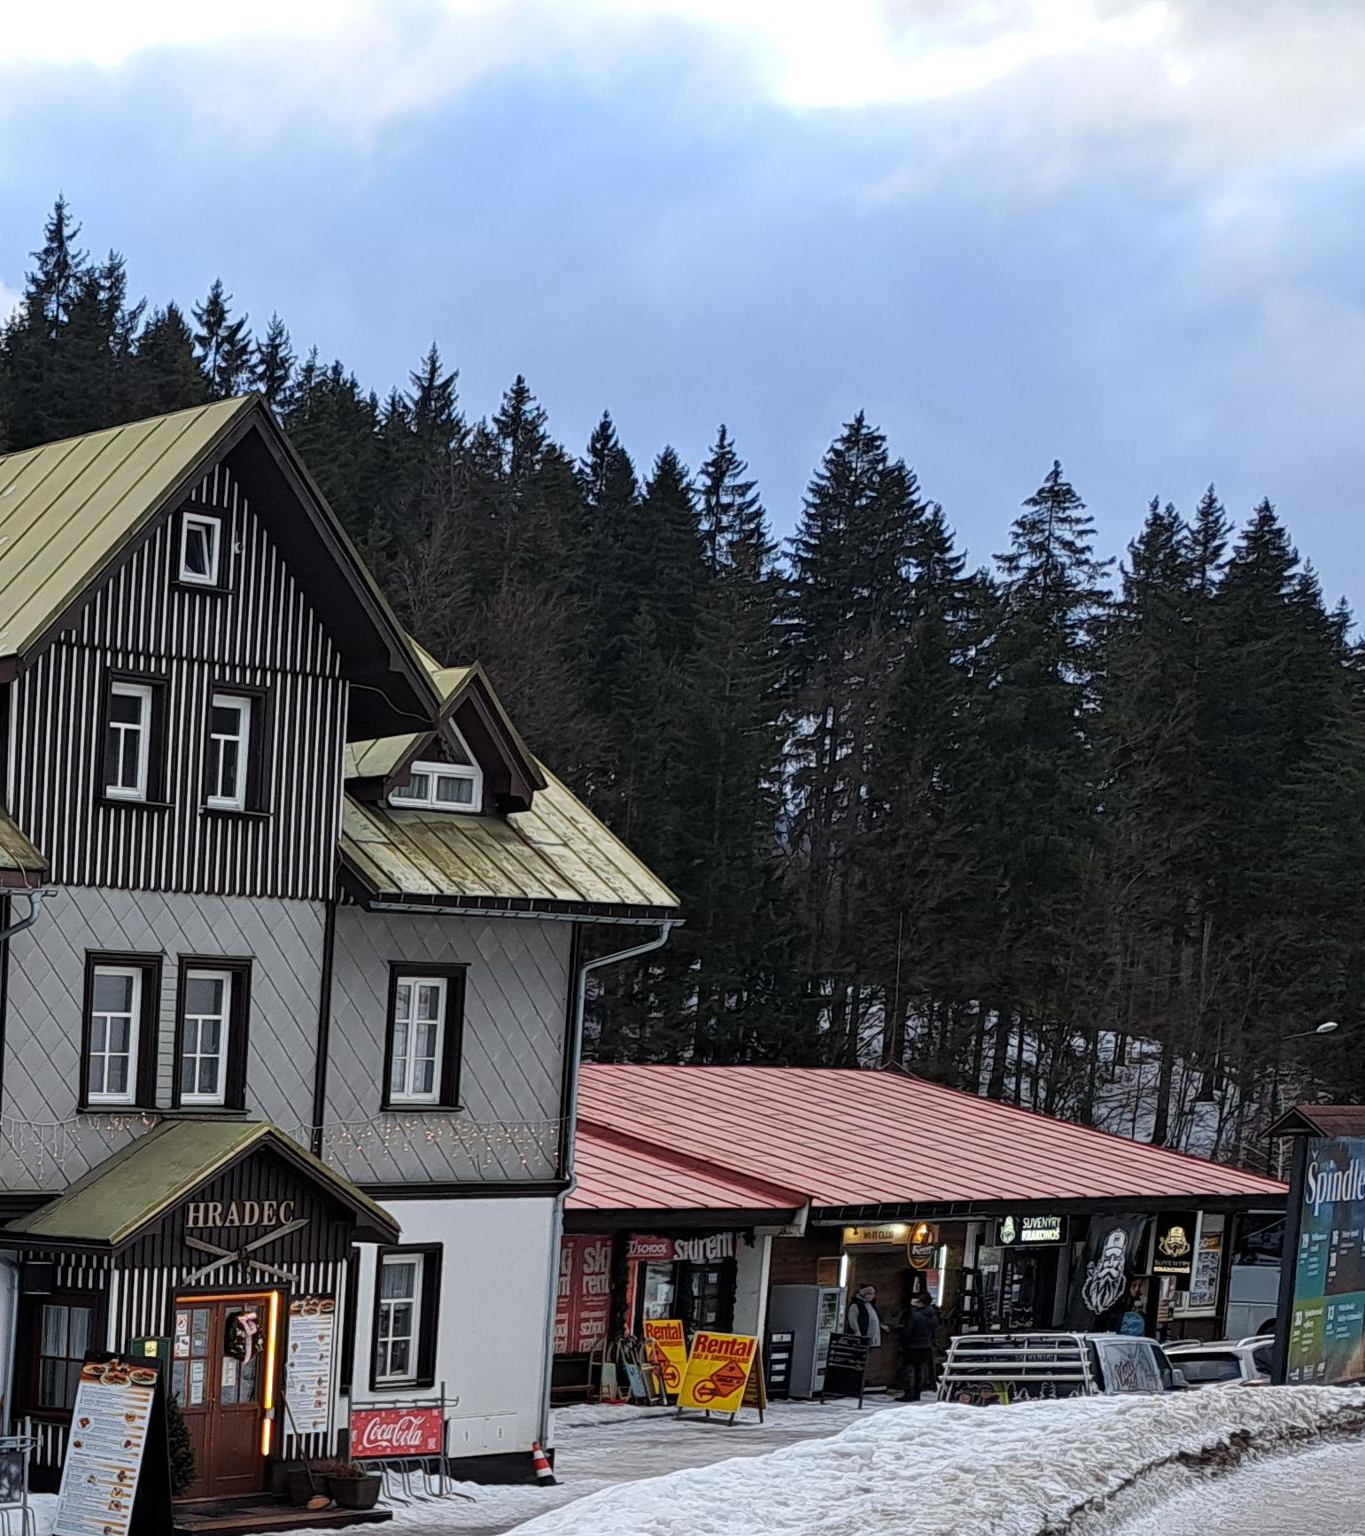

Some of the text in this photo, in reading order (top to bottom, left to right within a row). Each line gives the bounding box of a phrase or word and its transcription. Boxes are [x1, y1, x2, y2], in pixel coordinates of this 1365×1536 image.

[185, 1200, 295, 1228] HRADEC
[645, 1322, 682, 1341] Rental
[693, 1334, 755, 1357] Rental
[362, 1416, 426, 1448] Coca-Cola
